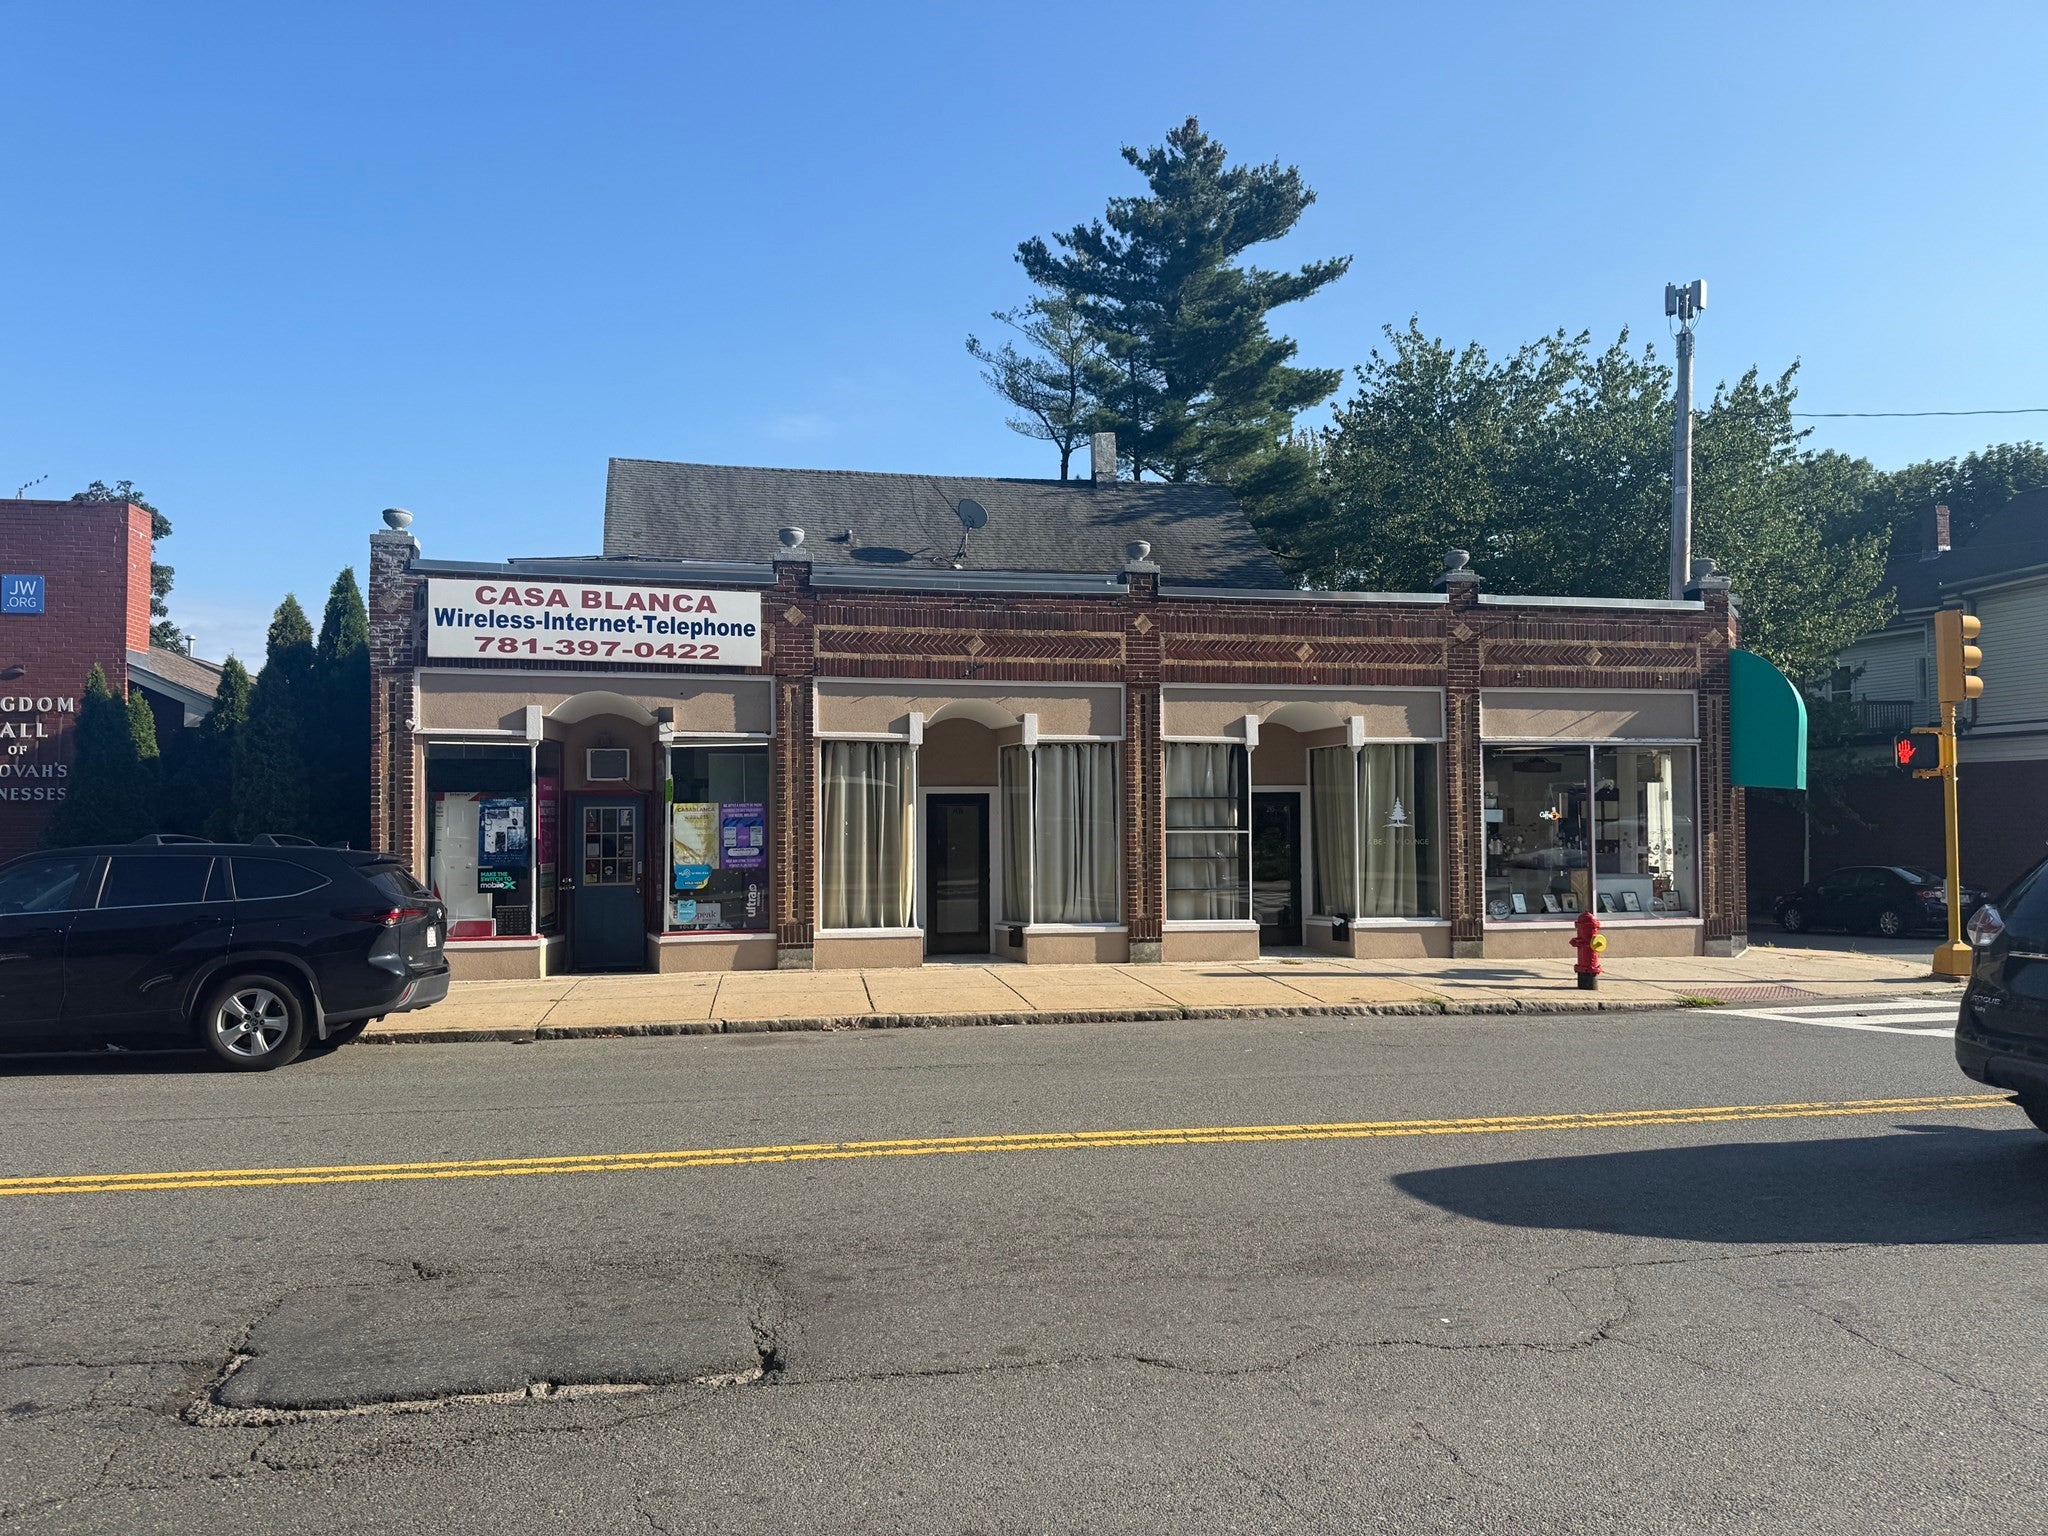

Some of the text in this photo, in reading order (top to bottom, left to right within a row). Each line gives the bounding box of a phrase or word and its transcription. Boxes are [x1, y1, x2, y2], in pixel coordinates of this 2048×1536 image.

[9, 580, 37, 596] JW
[475, 585, 718, 614] CASA BLANCA
[434, 607, 756, 640] Wireless-Internet-Telephone
[473, 636, 721, 660] 781-397-0422
[7, 745, 28, 755] OF
